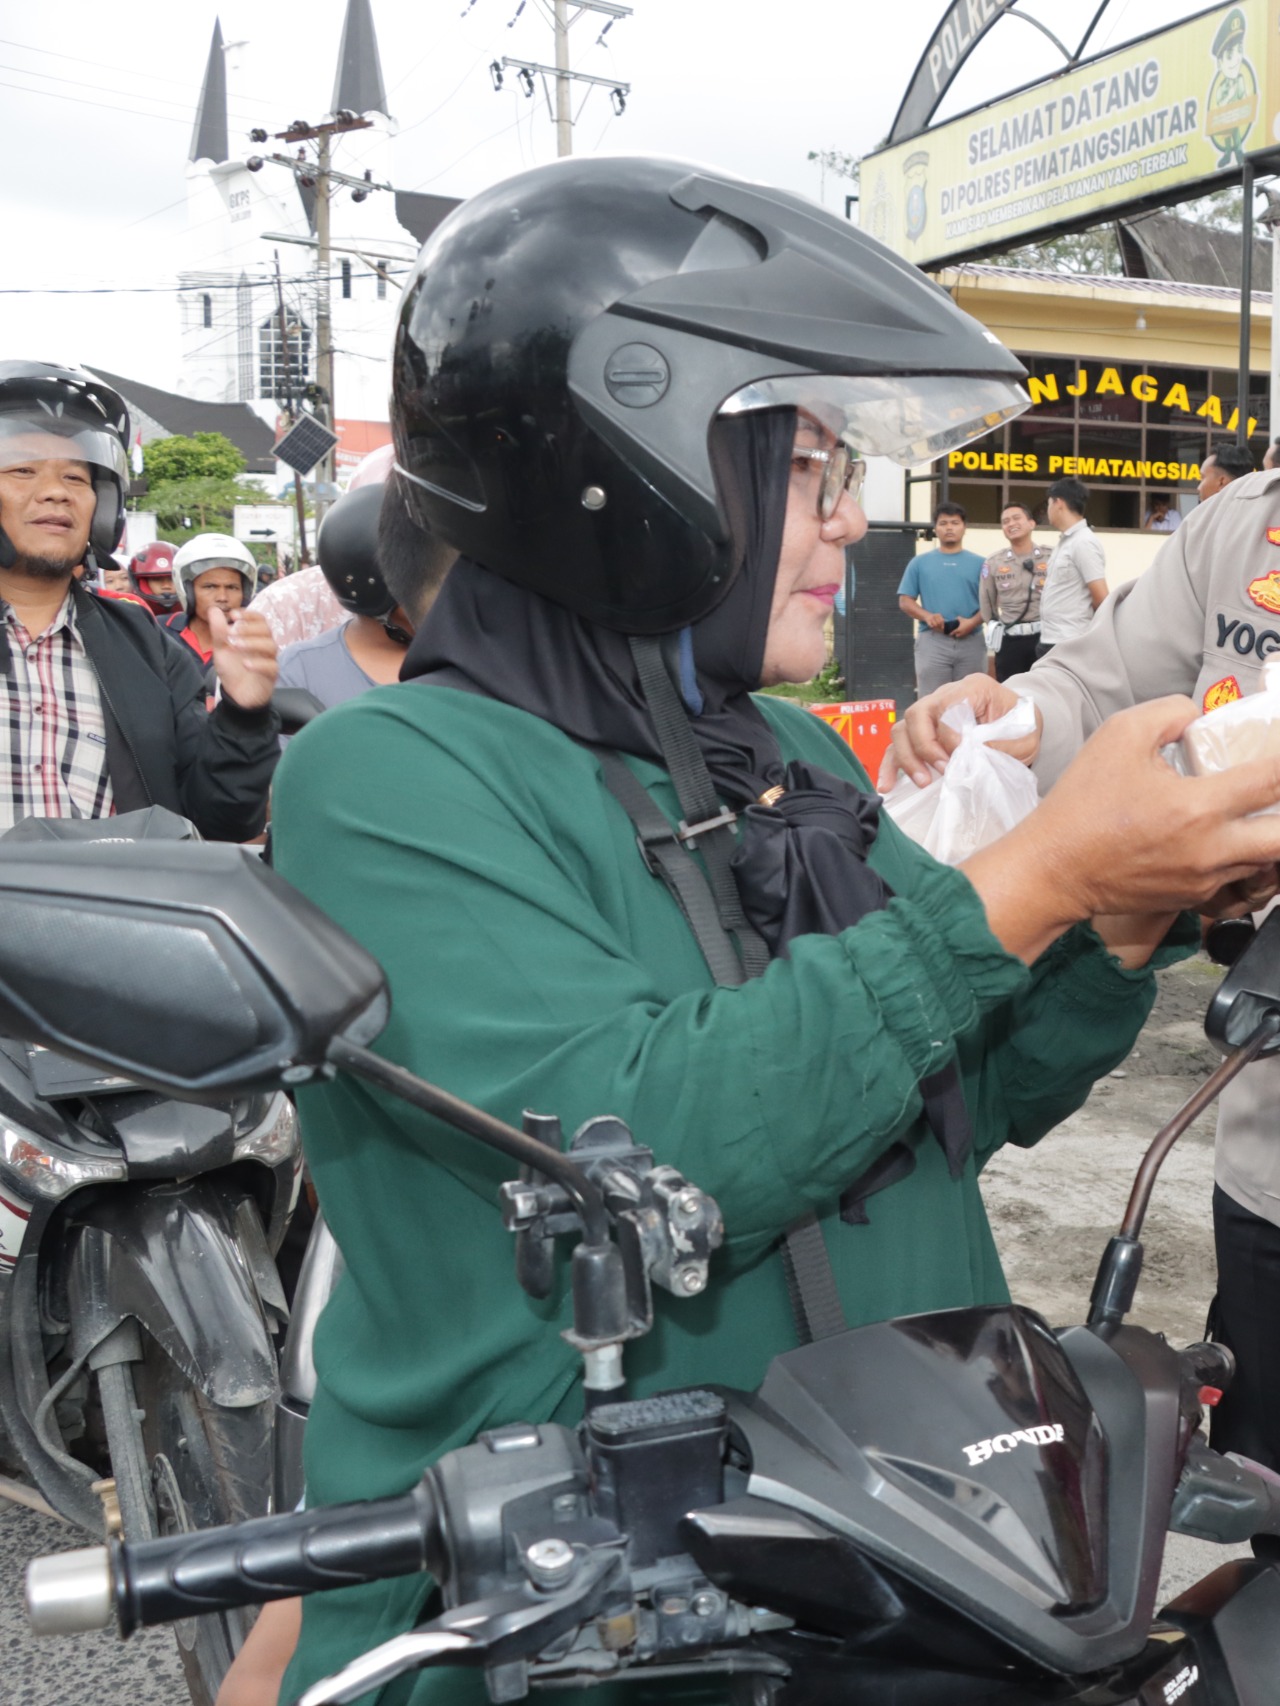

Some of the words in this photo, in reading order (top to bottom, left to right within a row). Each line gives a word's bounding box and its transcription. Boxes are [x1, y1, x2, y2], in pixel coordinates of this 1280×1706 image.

[928, 0, 1005, 94] POLR
[968, 101, 1058, 165] SELAMAT
[1061, 60, 1160, 131] DATANG
[941, 187, 954, 215] DI
[957, 168, 1010, 209] POLRES
[1014, 99, 1198, 191] PEMATANGSIANTAR
[1045, 171, 1107, 207] PELAYANAN
[1106, 160, 1139, 188] YANG
[1139, 143, 1188, 177] TERBAIK
[1027, 367, 1258, 440] NJAGAAN
[948, 450, 1039, 473] POLRES
[1049, 455, 1202, 481] PEMATANGSIA
